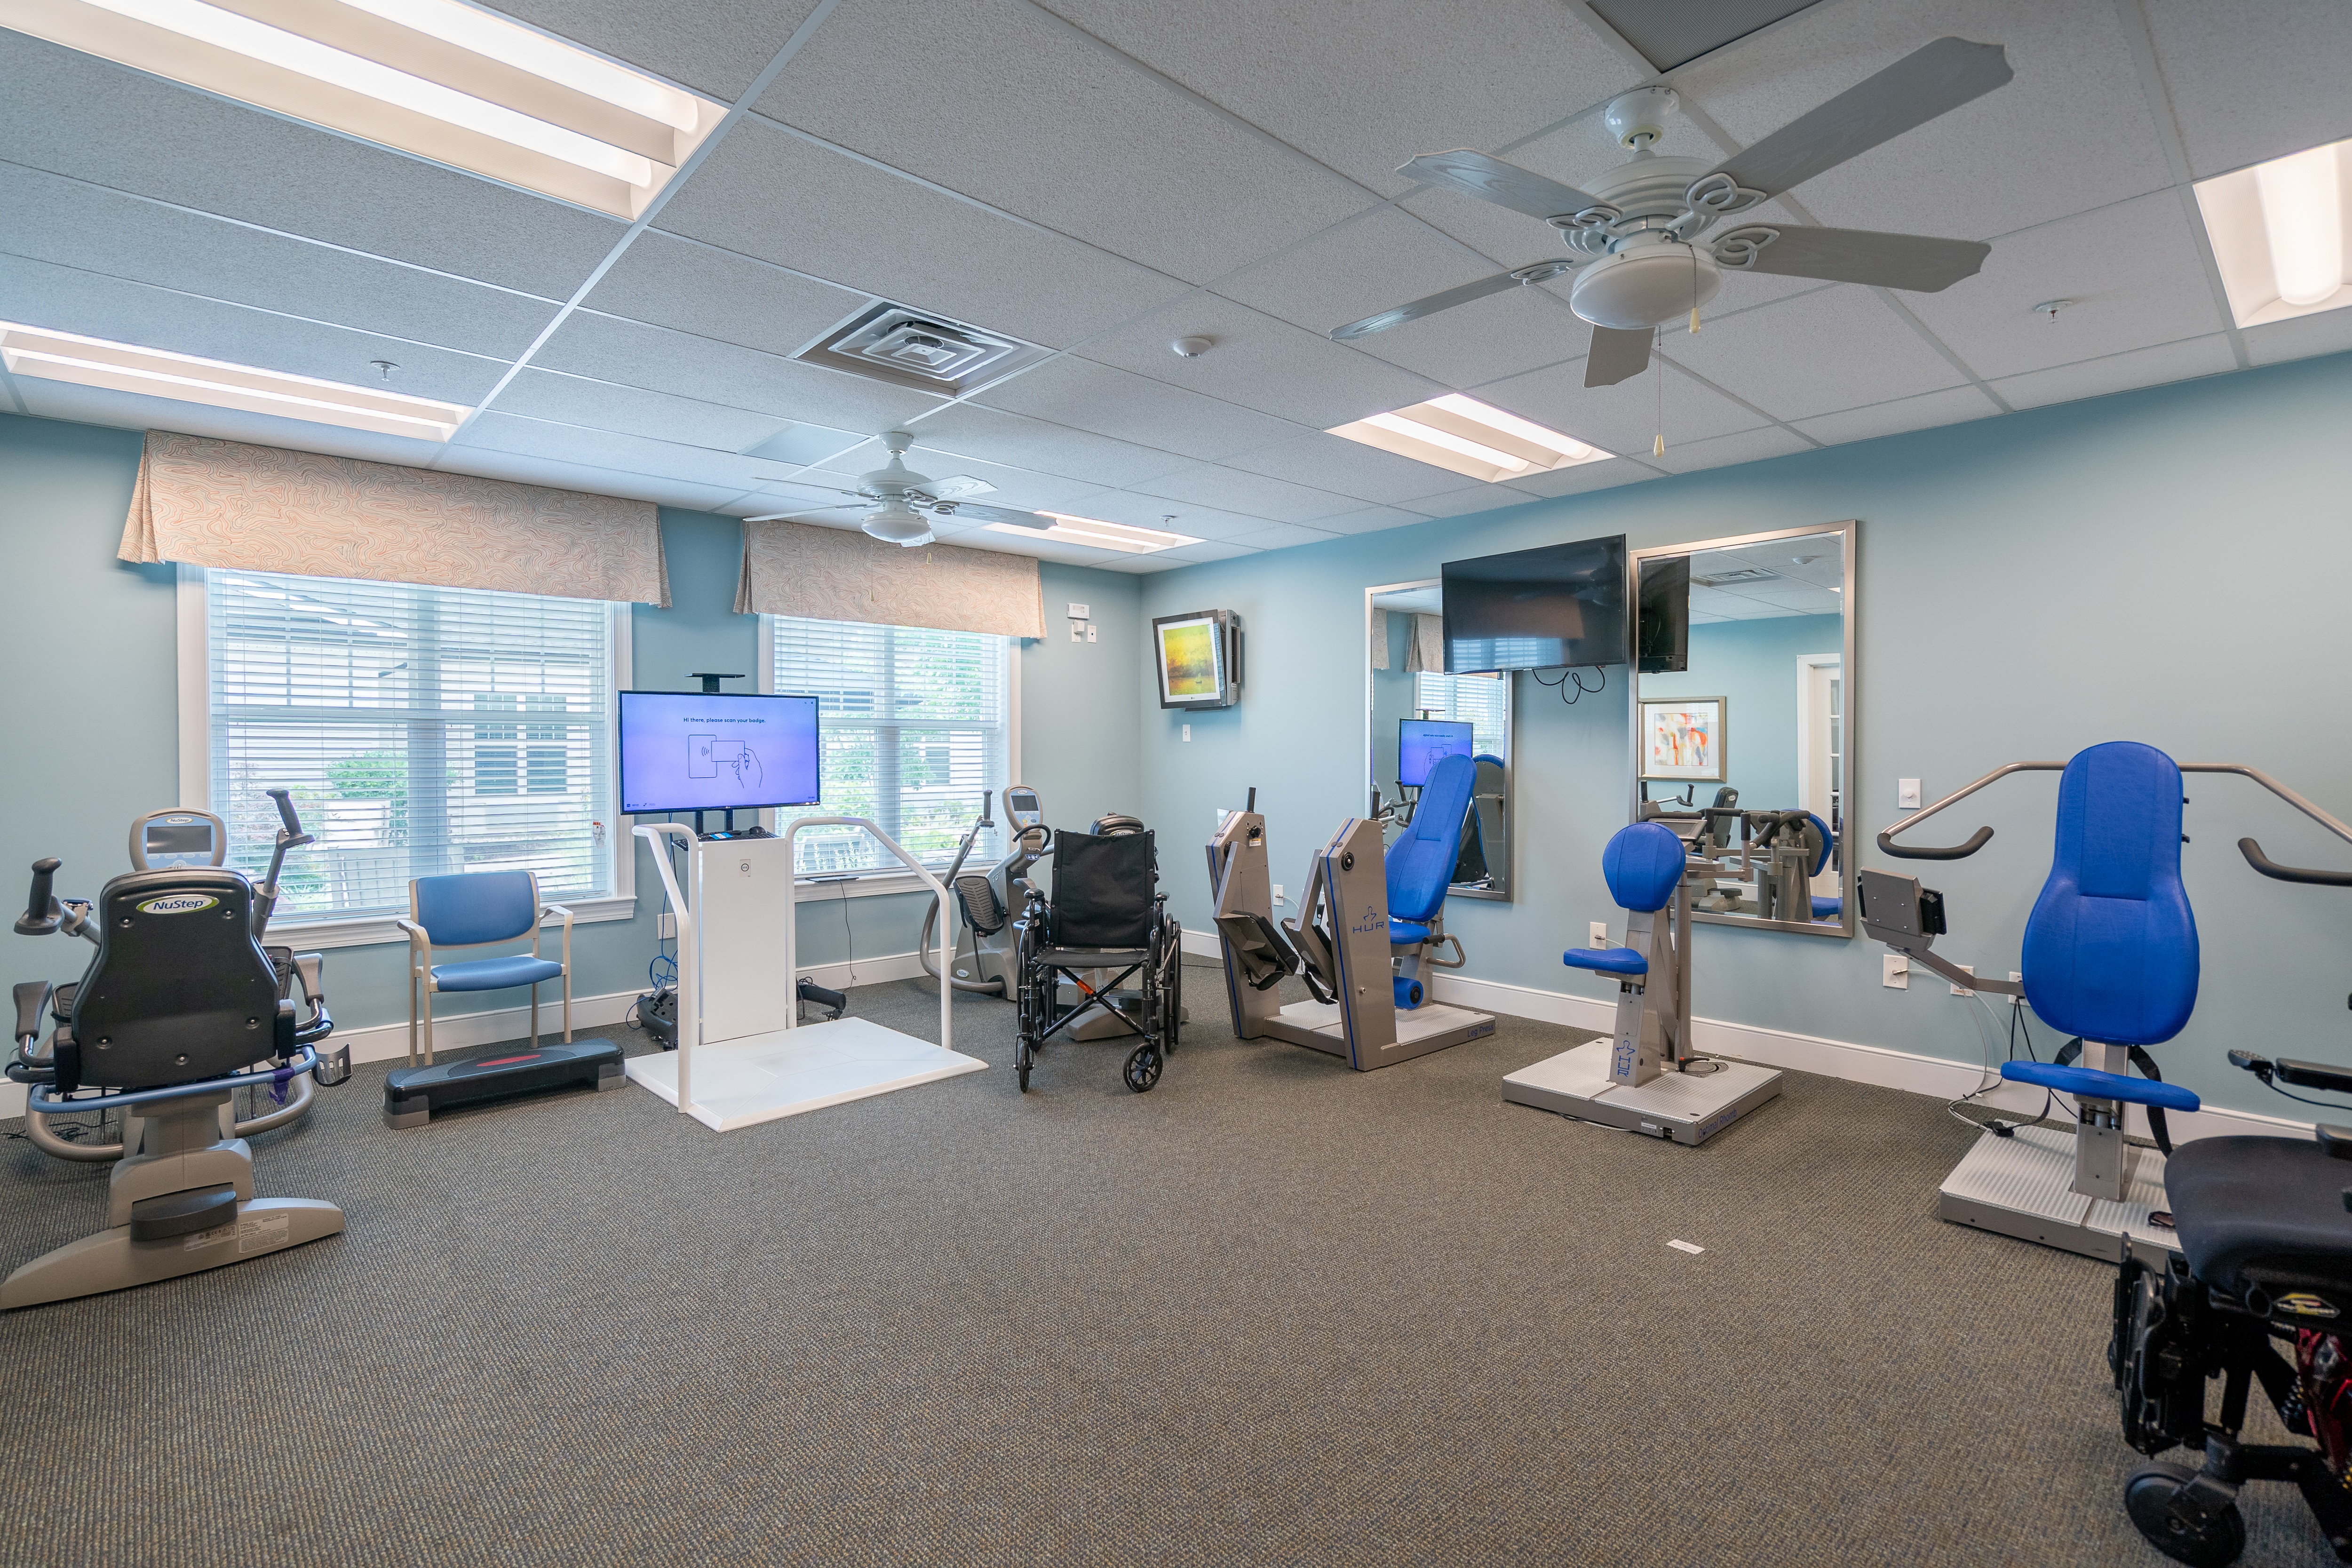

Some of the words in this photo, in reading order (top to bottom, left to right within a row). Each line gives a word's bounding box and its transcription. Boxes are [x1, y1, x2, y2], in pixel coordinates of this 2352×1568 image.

[153, 899, 204, 910] NuStep
[1353, 922, 1384, 934] HUR
[1479, 1024, 1494, 1034] Press
[1617, 1055, 1631, 1077] HUR
[1698, 1118, 1718, 1138] Optimal
[1720, 1108, 1737, 1126] Rhomb
